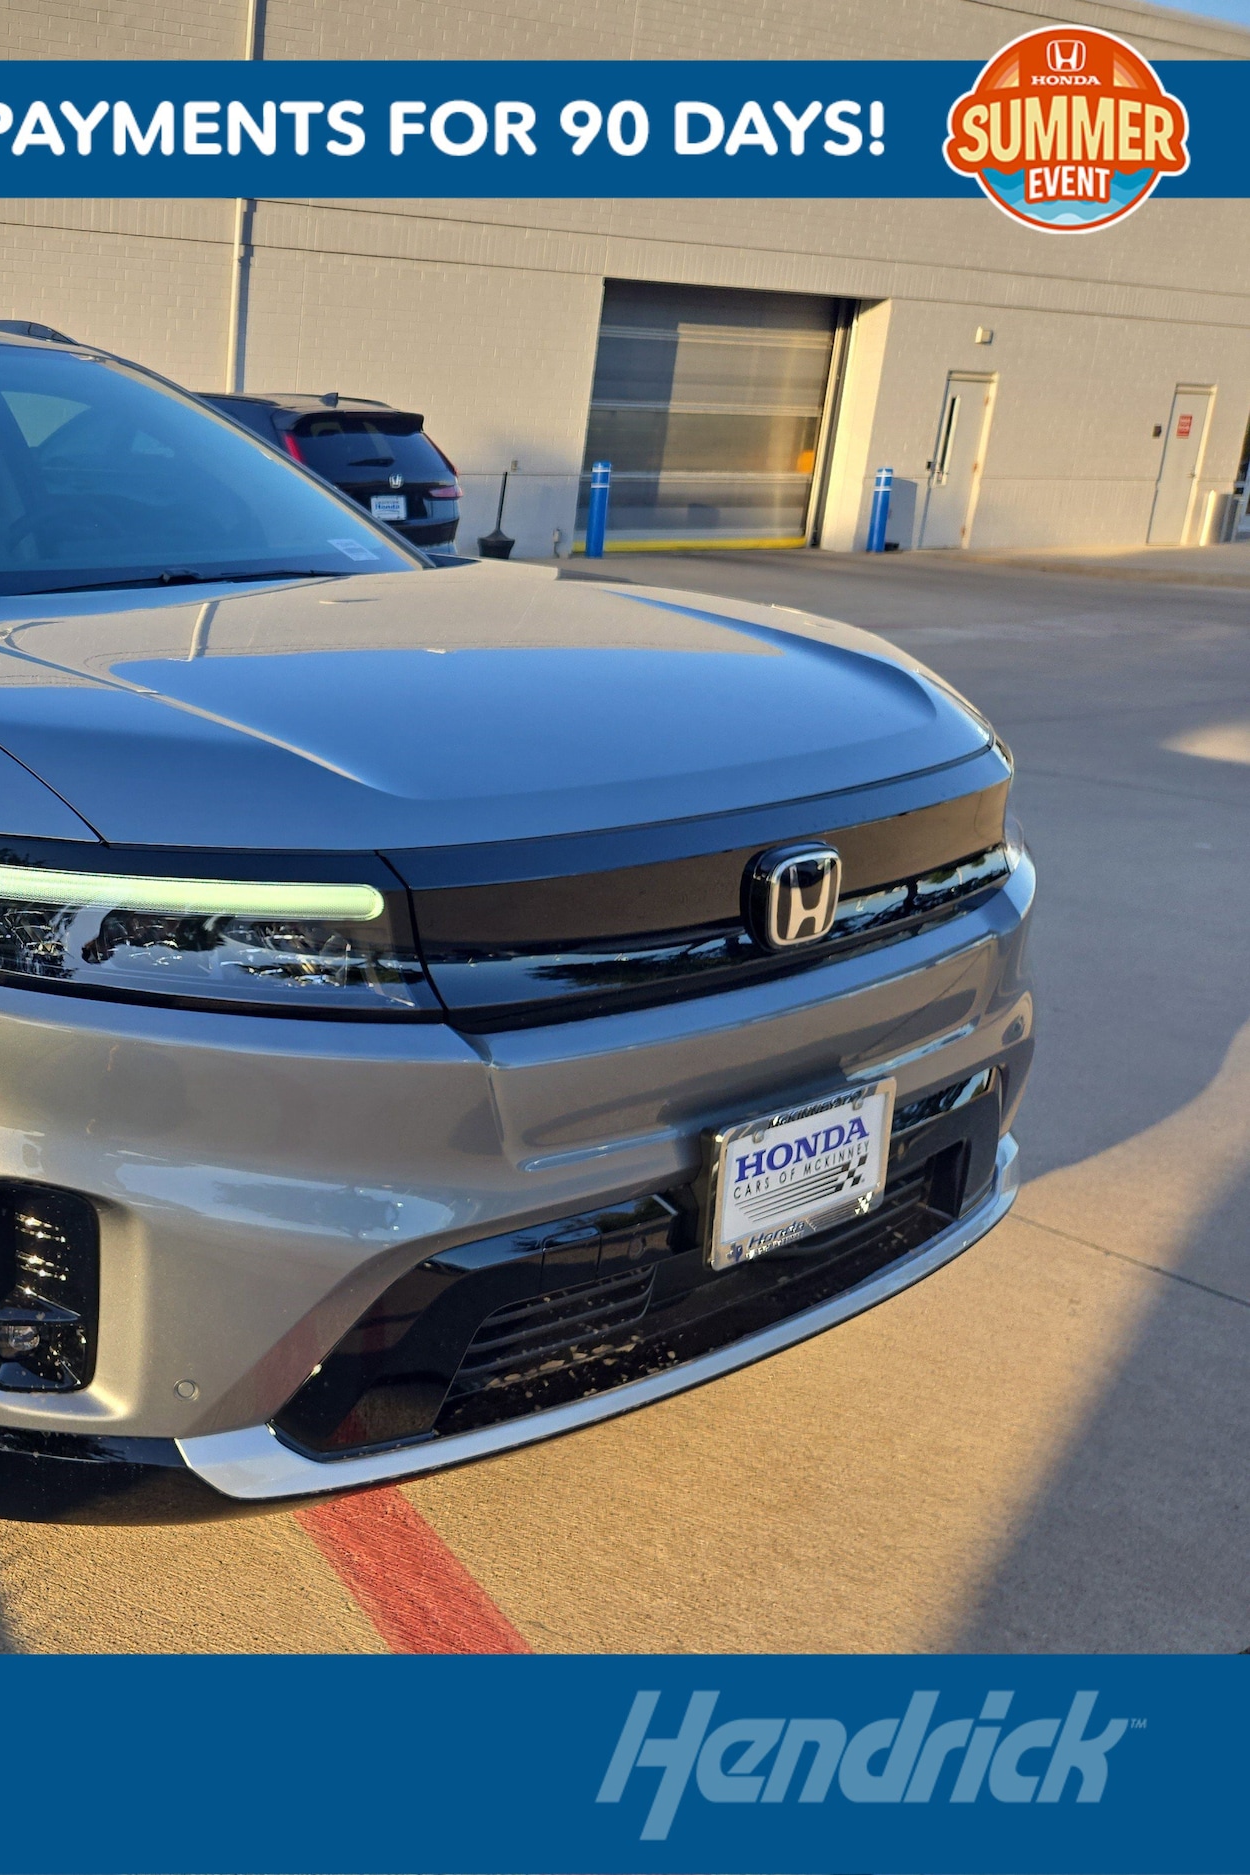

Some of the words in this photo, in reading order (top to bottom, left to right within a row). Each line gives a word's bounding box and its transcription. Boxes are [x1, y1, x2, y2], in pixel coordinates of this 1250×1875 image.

[733, 1177, 769, 1199] CARS
[779, 1170, 795, 1185] OF
[803, 1140, 869, 1176] MCKINNEY
[734, 1116, 870, 1183] HONDA
